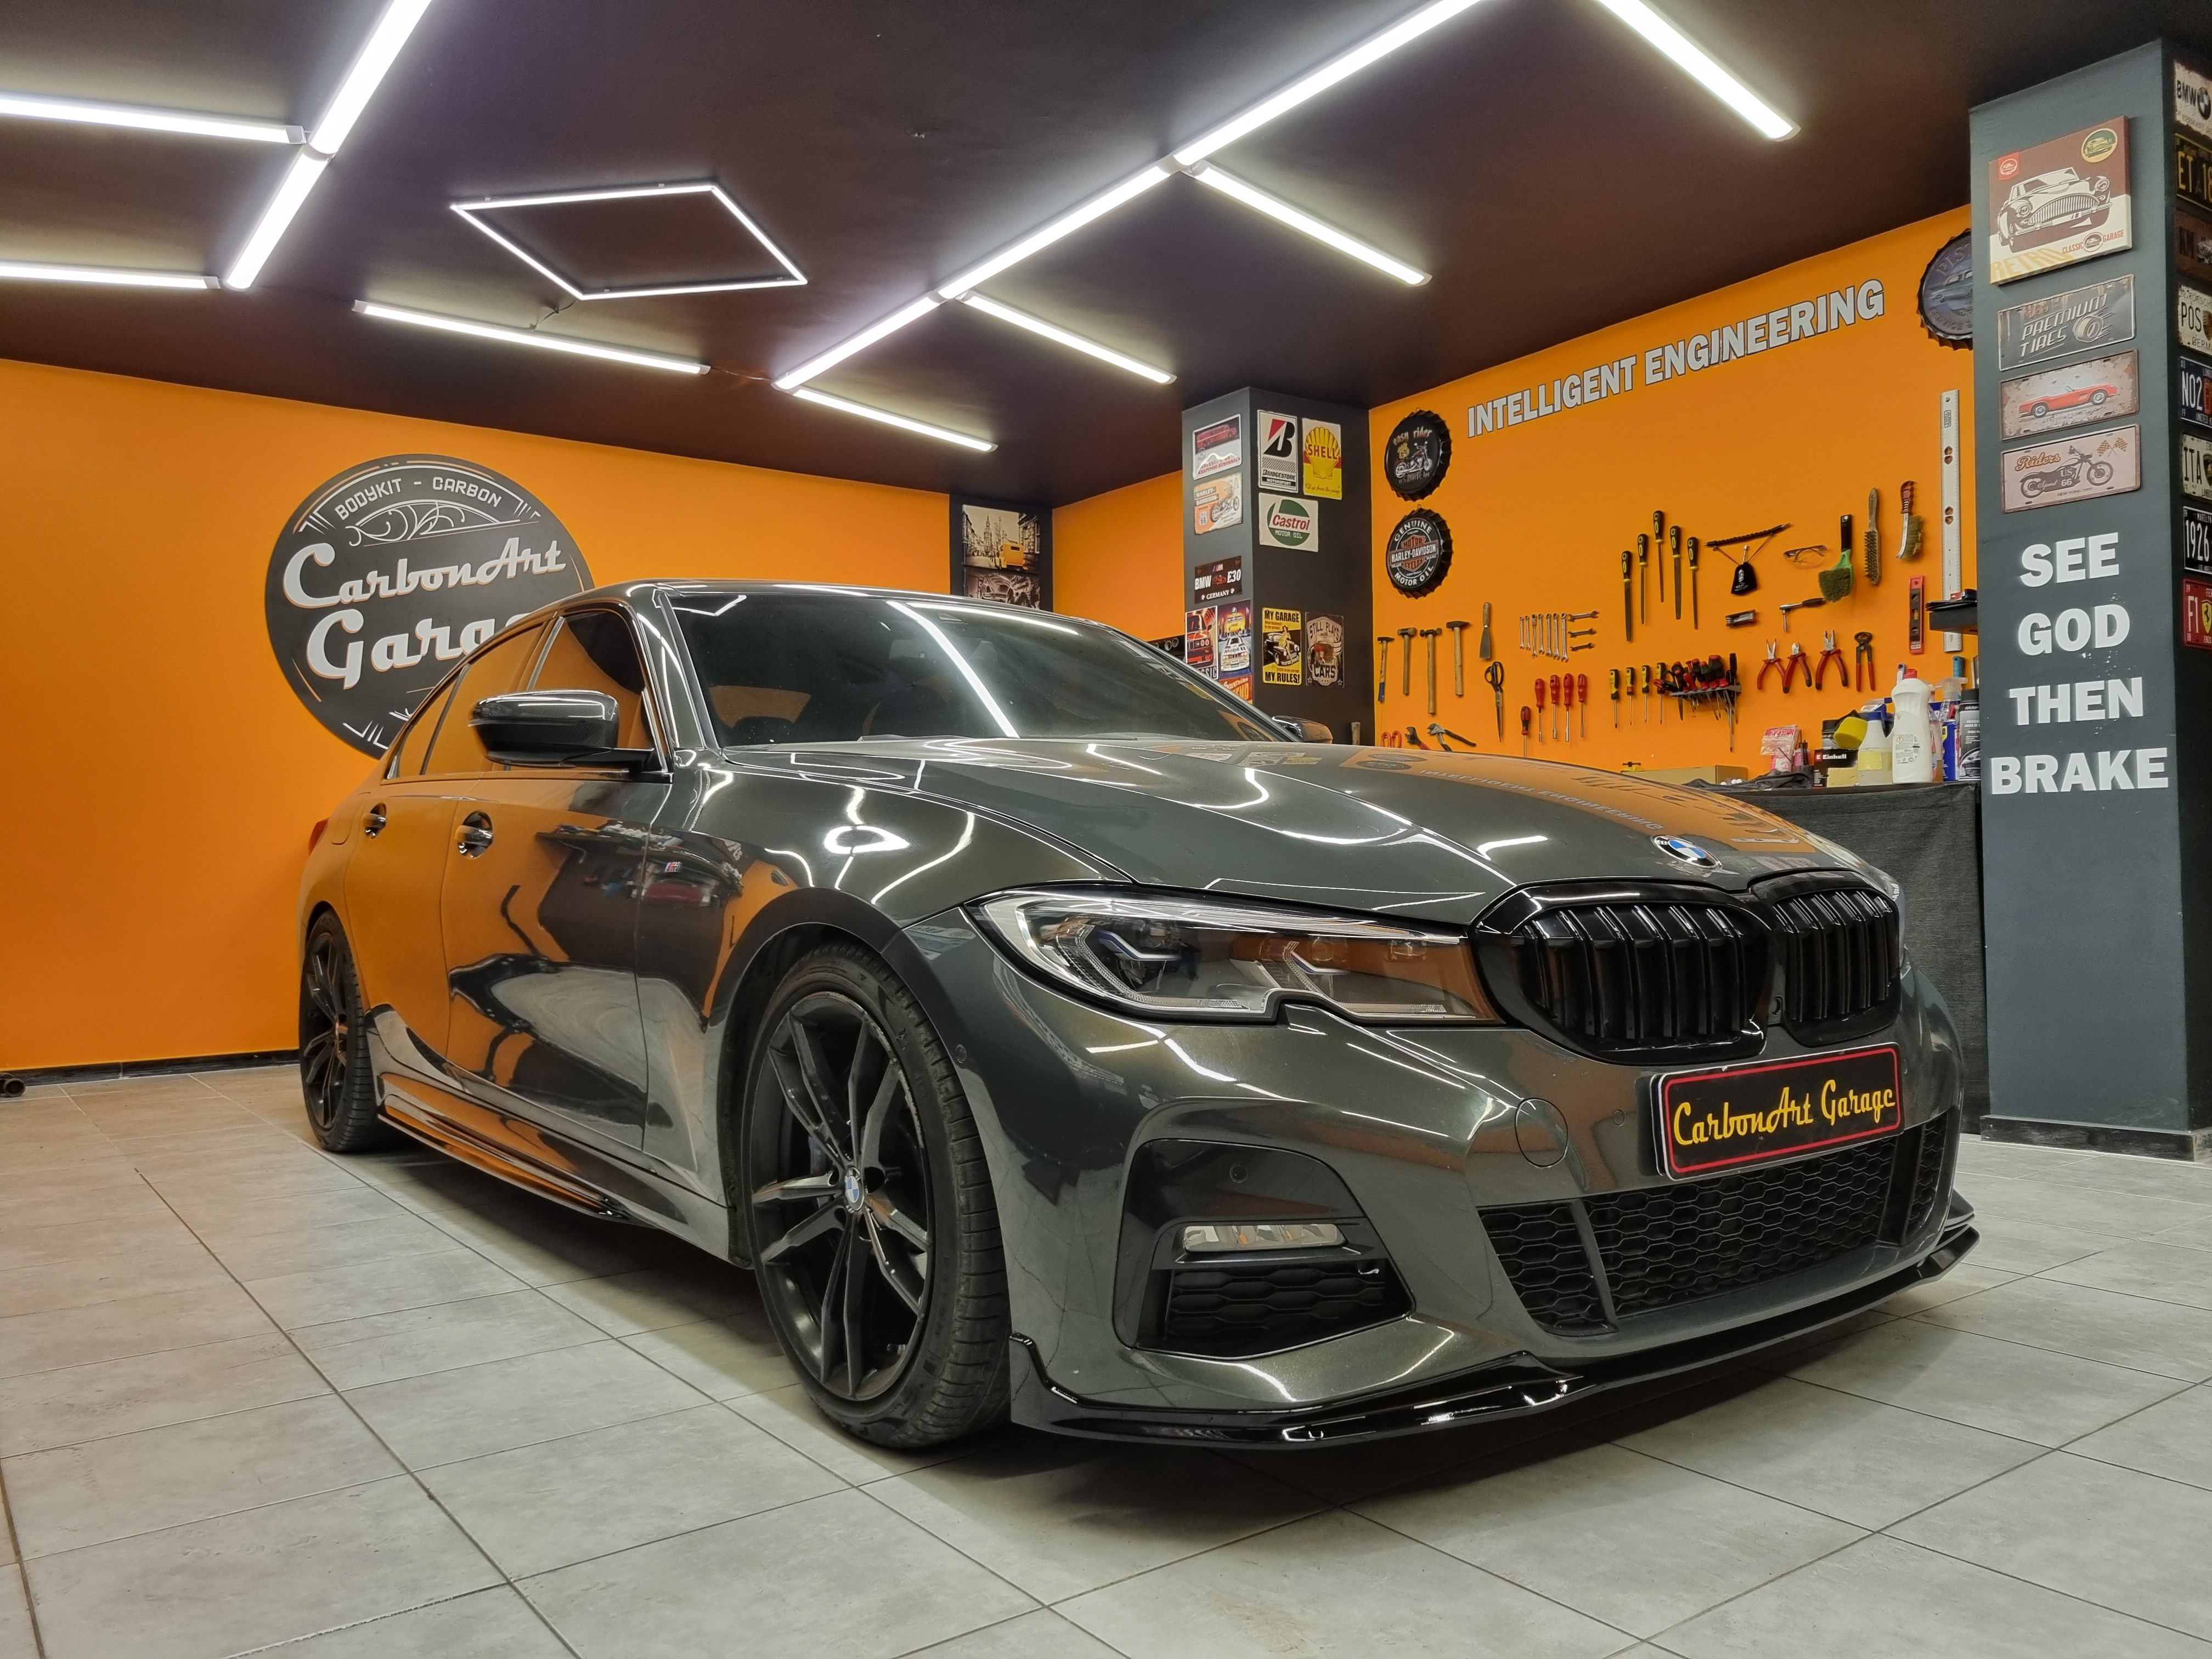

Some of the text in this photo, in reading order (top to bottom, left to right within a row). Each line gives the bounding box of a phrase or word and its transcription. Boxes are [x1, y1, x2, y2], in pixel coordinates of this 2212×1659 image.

[2177, 80, 2197, 107] BMW
[2102, 229, 2124, 242] GARAGE
[2062, 242, 2084, 255] CLASSIC
[1991, 248, 2075, 283] RETRO
[2021, 293, 2107, 341] PREMIUM
[2181, 301, 2202, 332] POS
[2020, 325, 2068, 357] TIRES
[1468, 279, 1884, 438] INTELLIGENT ENGINEERING
[1413, 426, 1433, 438] rider
[1307, 443, 1338, 460] SHELL
[2015, 452, 2061, 472] Riders
[1262, 469, 1296, 481] BRIDGESTONE
[335, 478, 402, 521] BODYKIT
[432, 477, 502, 507] CARBON
[1272, 515, 1311, 531] Castrol
[1275, 529, 1291, 538] MOTOR
[1394, 520, 1432, 542] GENUINE
[1403, 536, 1423, 548] MOTOR
[2186, 520, 2210, 562] 1926
[1391, 543, 1436, 563] HARLEY-DAVIDSON
[1404, 558, 1423, 569] CYCLES
[2020, 532, 2120, 588] SEE
[283, 537, 566, 609] CarbonArt
[1195, 568, 1242, 590] BMW E30
[1394, 566, 1434, 586] MOTOR OIL
[1206, 589, 1229, 600] GERMANY
[1265, 610, 1300, 623] MY GARAGE
[2188, 595, 2199, 633] F1
[1309, 622, 1339, 642] STILL PLAYS
[2018, 604, 2130, 656] GOD
[306, 608, 531, 690] Gara
[1265, 672, 1300, 684] MY RULES!
[1314, 664, 1336, 679] CARS
[2009, 677, 2143, 726] THEN
[1990, 747, 2169, 795] BRAKE
[1673, 1079, 1895, 1146] CarbonArt Garage
